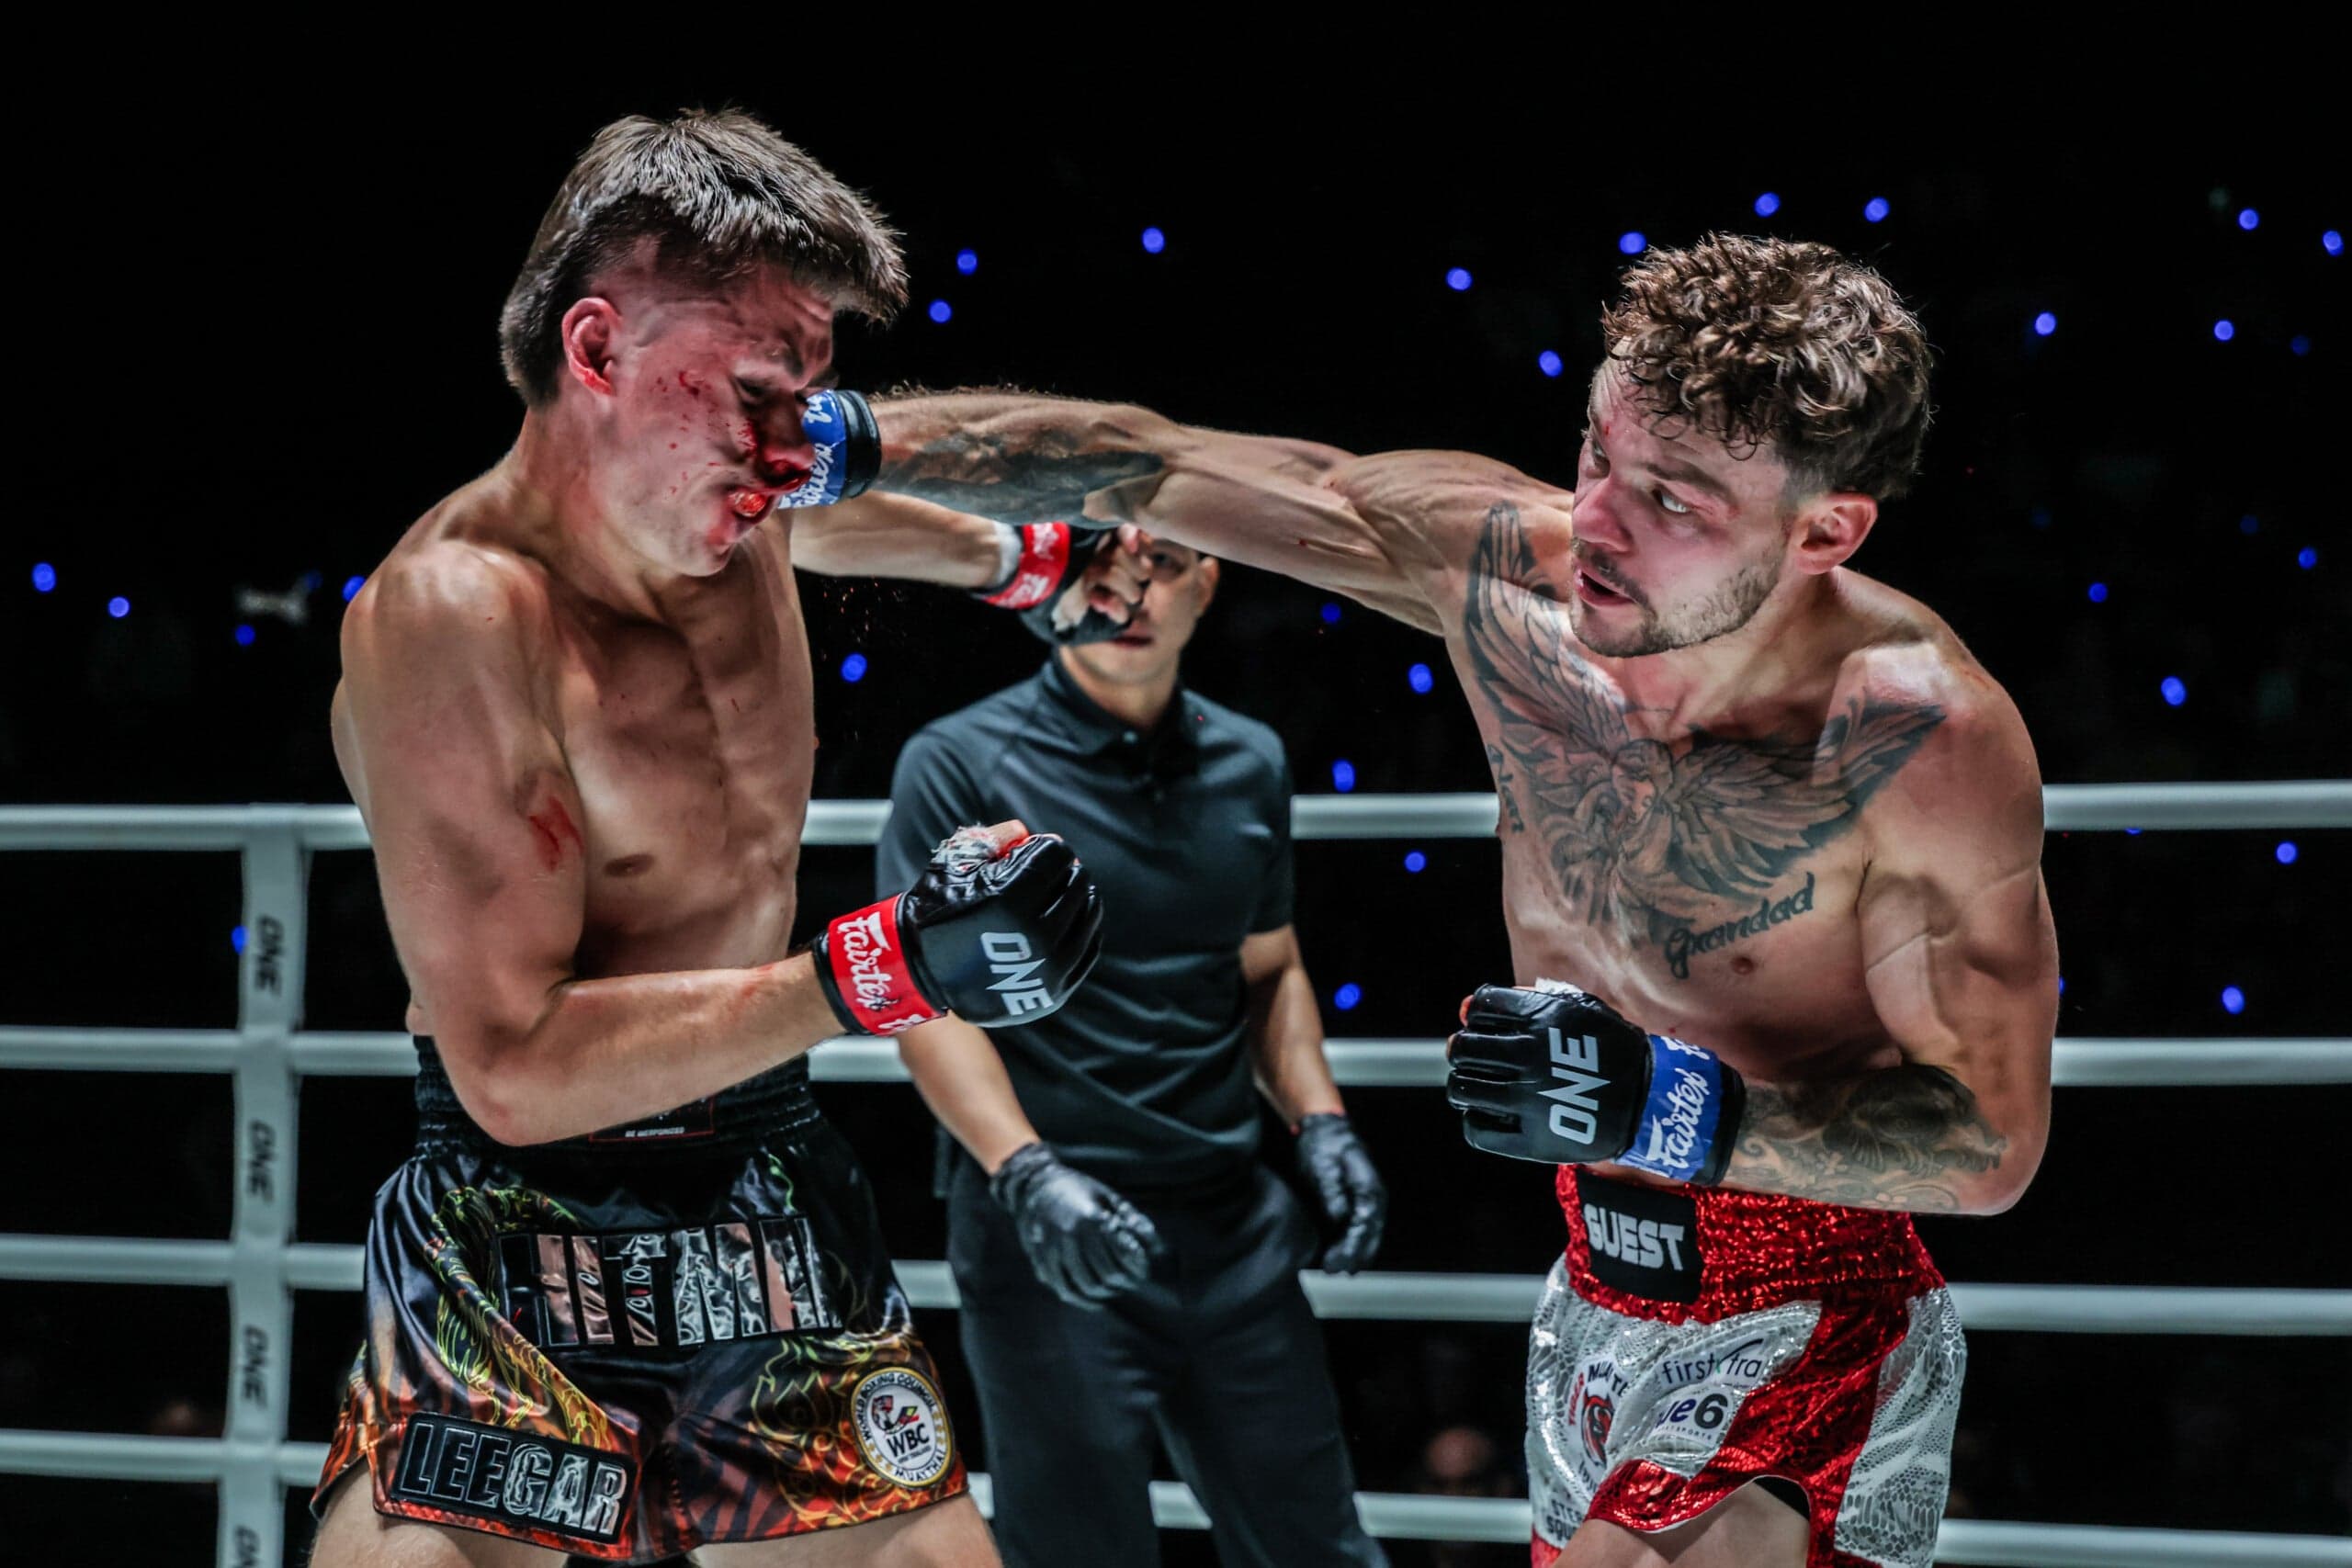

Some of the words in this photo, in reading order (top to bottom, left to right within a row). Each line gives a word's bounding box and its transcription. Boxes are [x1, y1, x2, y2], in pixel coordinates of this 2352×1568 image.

[980, 932, 1054, 1016] ONE
[1536, 1027, 1611, 1145] ONE
[1645, 1066, 1711, 1169] Fairtex
[1583, 1202, 1686, 1272] GUEST
[897, 1373, 938, 1412] COUNCIL
[399, 1422, 628, 1535] LEEGAR
[886, 1423, 930, 1458] WBC
